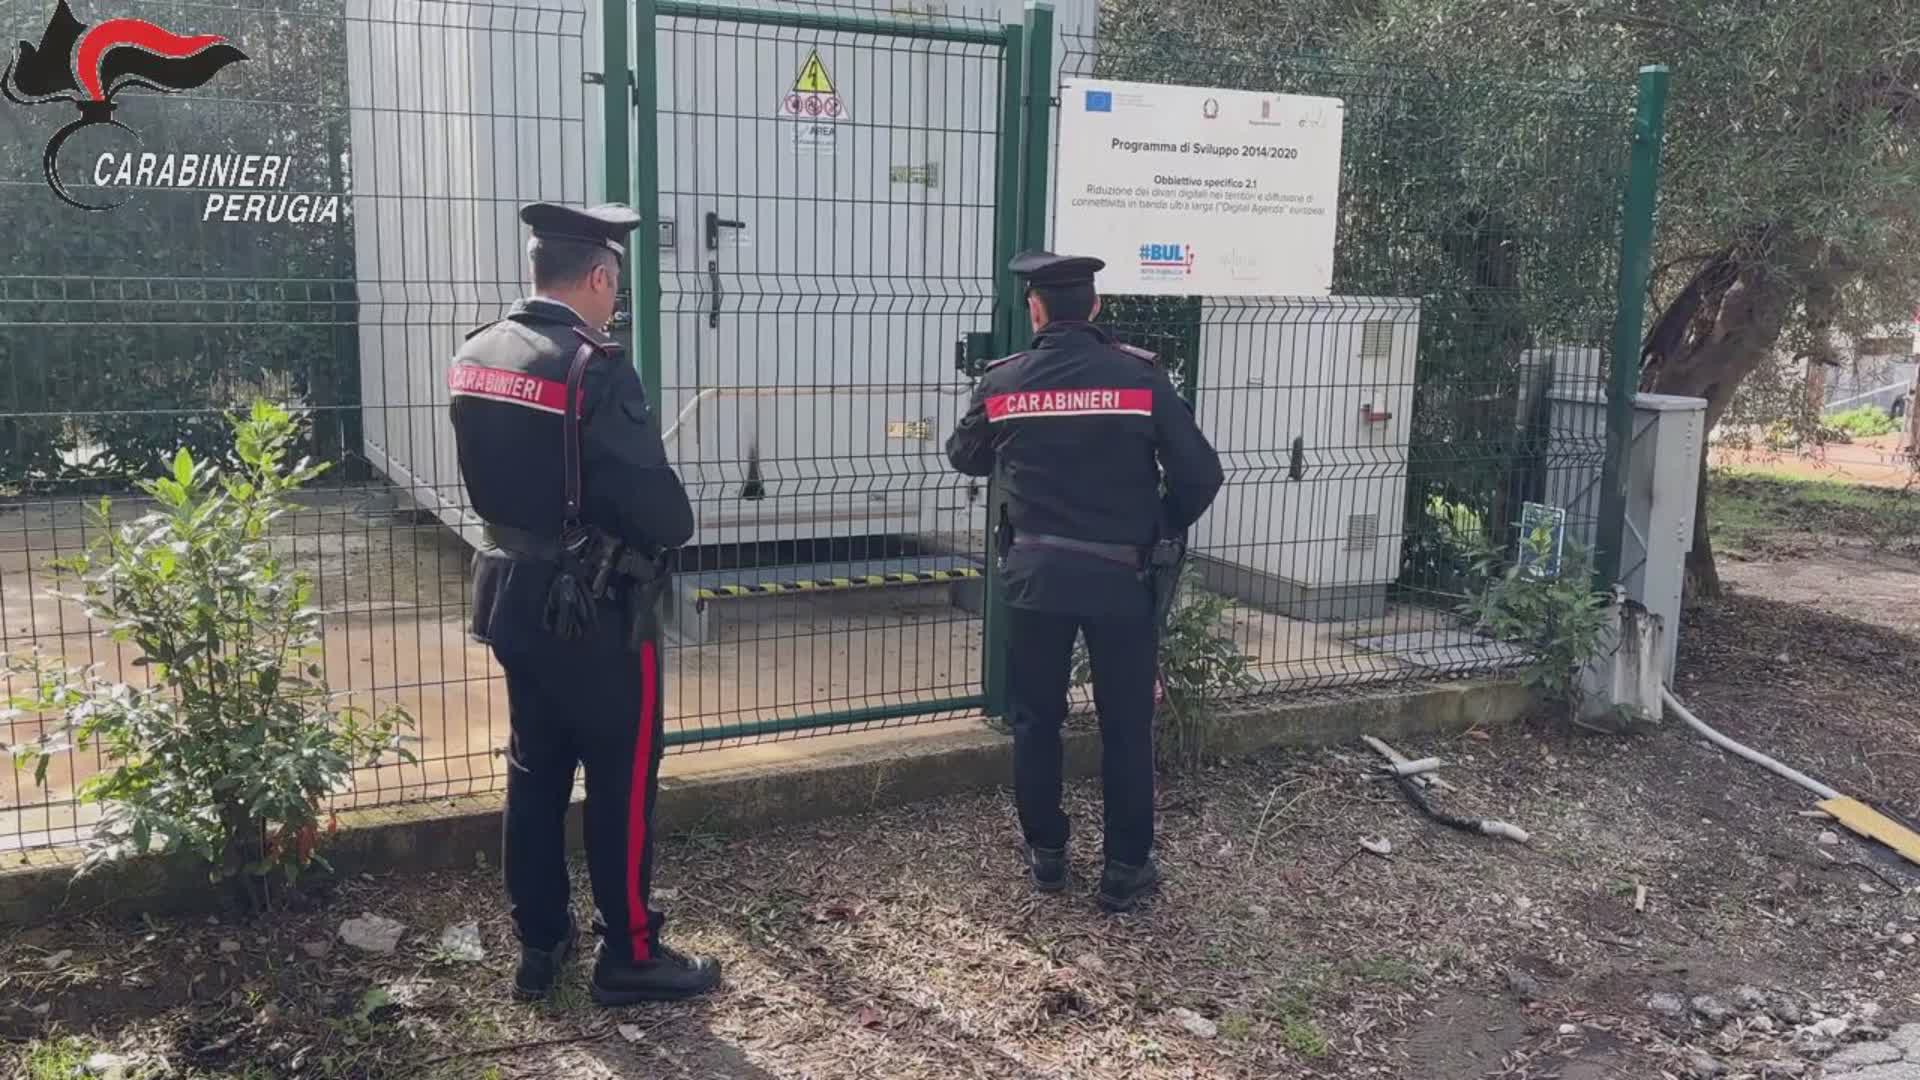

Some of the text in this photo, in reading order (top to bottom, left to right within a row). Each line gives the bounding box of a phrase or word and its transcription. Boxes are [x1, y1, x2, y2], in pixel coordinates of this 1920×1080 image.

[1111, 137, 1298, 159] Programma di Sviluppo 2014/2020
[1087, 184, 1133, 195] Riduzione
[1153, 174, 1257, 188] Obbiettivo specifico 2.1
[1139, 244, 1184, 261] #BUL
[452, 369, 543, 401] CARABINIERI
[1006, 391, 1120, 412] CARABINIERI
